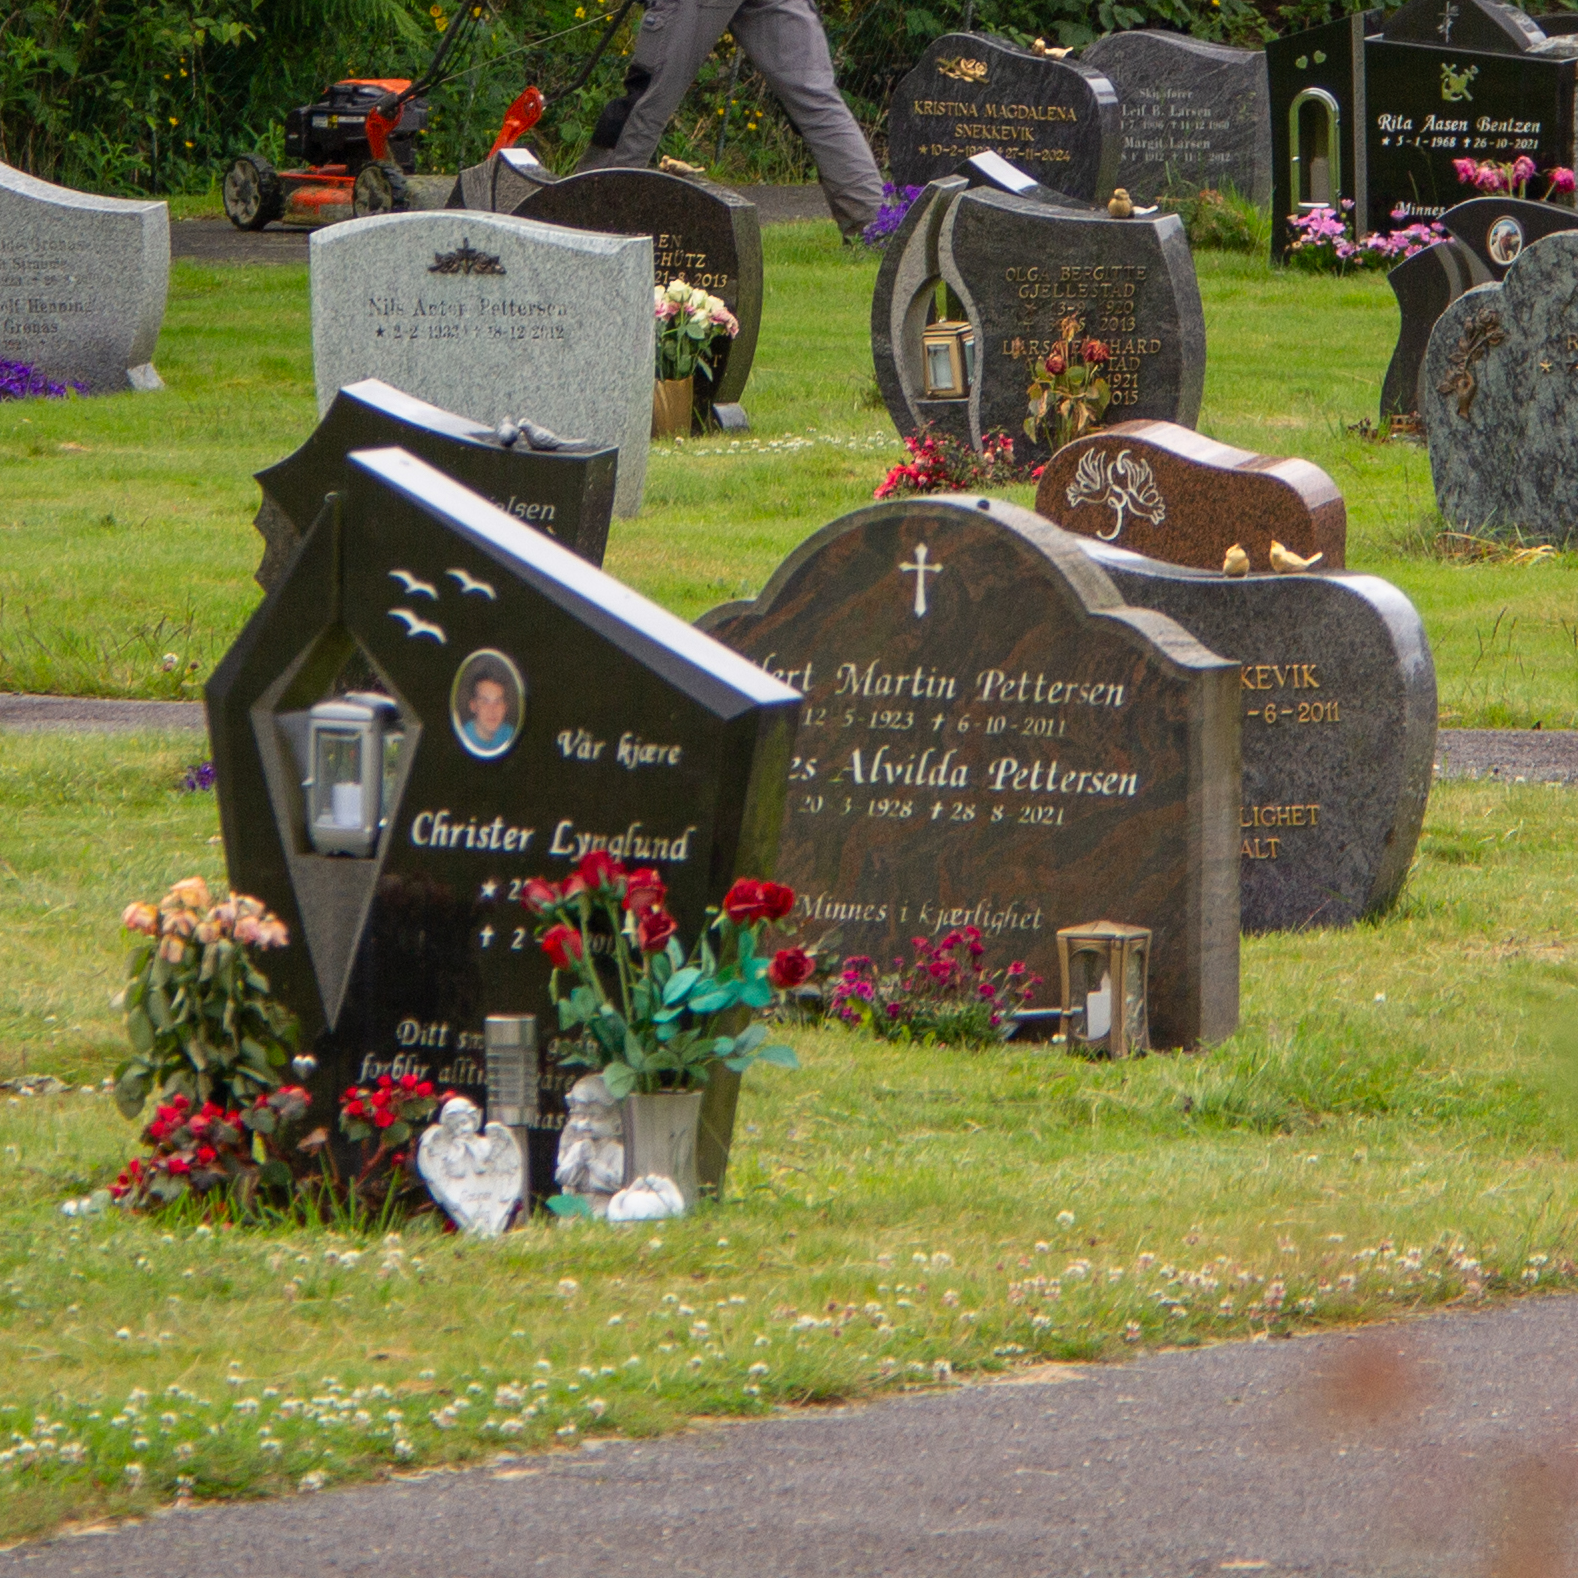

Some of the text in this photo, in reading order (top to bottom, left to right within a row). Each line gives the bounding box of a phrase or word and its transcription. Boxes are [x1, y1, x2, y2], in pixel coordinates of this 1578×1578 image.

[913, 100, 1077, 122] KRISTINA MAGDALENA
[955, 123, 1035, 141] SNEKKEVIK
[1377, 113, 1541, 134] Rita Aasen Bentzen
[653, 250, 708, 269] CHÜTZ
[1005, 266, 1050, 282] OLGA
[1018, 282, 1136, 300] GJELLESTAD
[1110, 390, 1139, 405] 015
[835, 658, 958, 699] Martin
[975, 667, 1126, 708] Pettersen
[1239, 664, 1321, 690] KEVIK
[828, 744, 970, 788] Alvilda
[987, 756, 1140, 797] Pettersen
[1239, 804, 1321, 828] LIGHET
[410, 809, 698, 863] Christer Lynglund
[795, 891, 889, 923] Minnes
[396, 1018, 450, 1049] Ditt
[438, 1059, 485, 1085] allti
